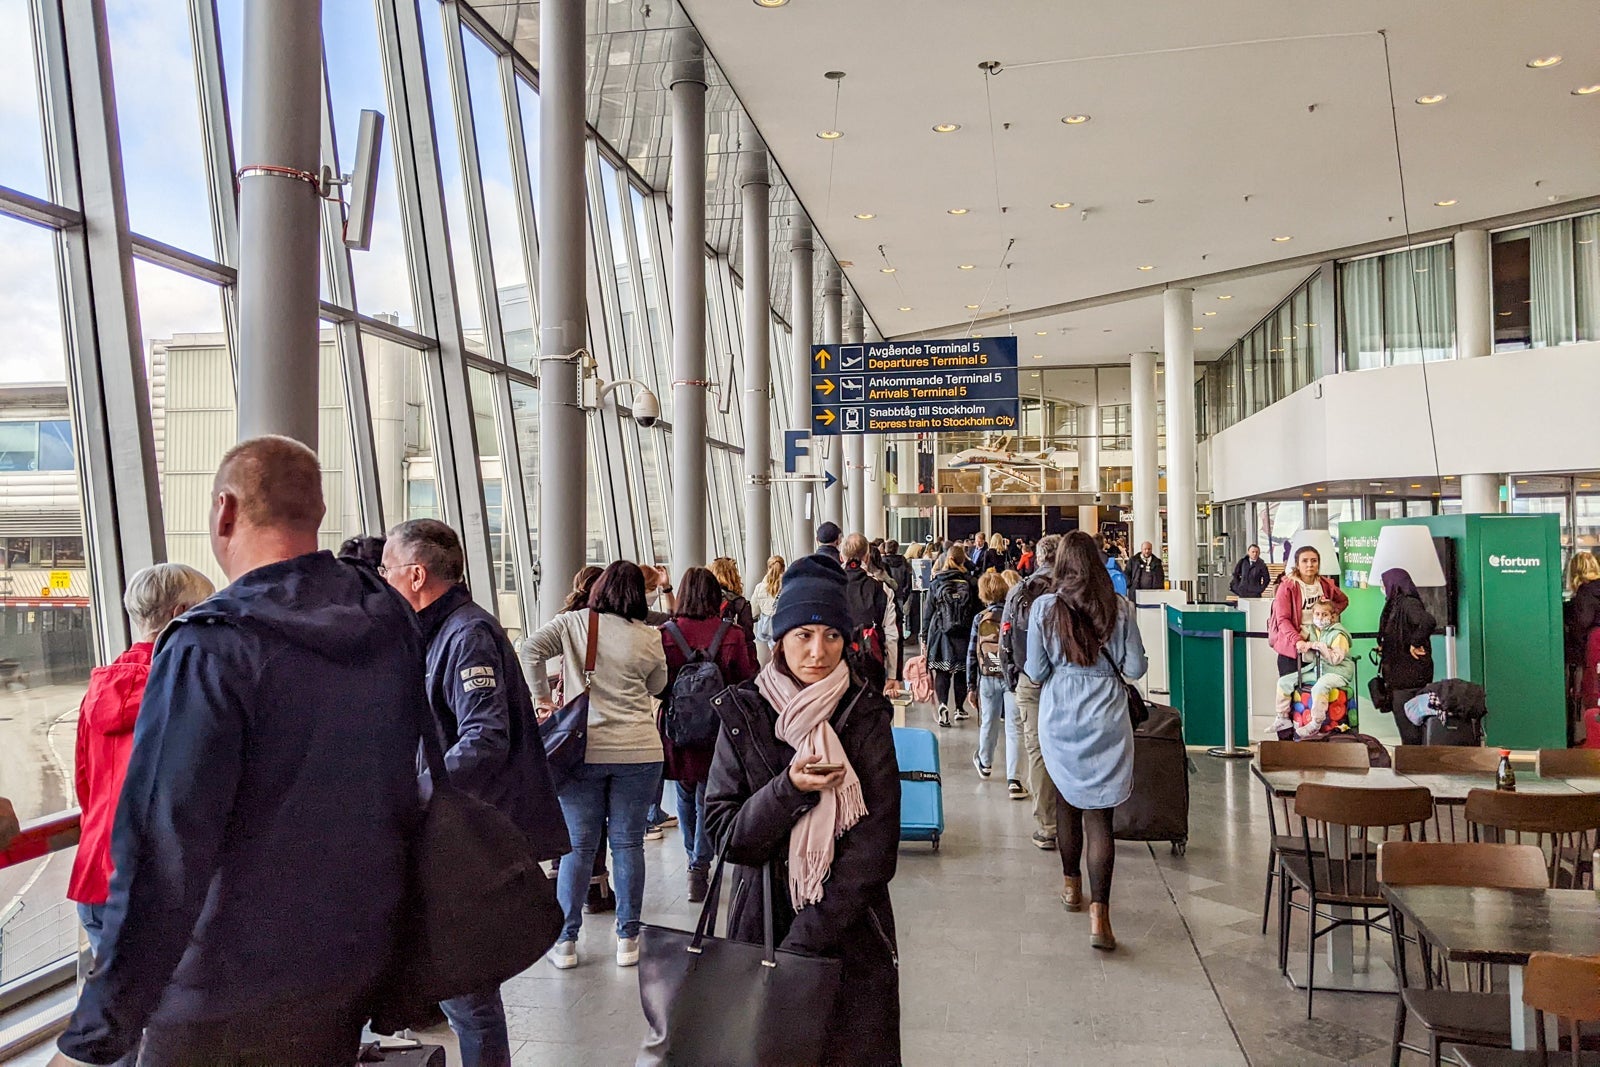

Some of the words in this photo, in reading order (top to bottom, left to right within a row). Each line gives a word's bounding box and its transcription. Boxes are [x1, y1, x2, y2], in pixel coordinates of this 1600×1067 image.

[868, 344, 922, 358] Avgående
[924, 342, 970, 354] Terminal
[972, 342, 980, 352] 5
[868, 357, 929, 370] Departures
[931, 354, 978, 366] Terminal
[980, 354, 988, 364] 5
[869, 374, 943, 387] Ankommande
[945, 373, 992, 384] Terminal
[994, 372, 1002, 382] 5
[869, 388, 909, 399] Arrivals
[911, 386, 958, 398] Terminal
[959, 386, 967, 396] 5
[869, 405, 917, 418] Snabbtåg
[918, 406, 930, 416] till
[931, 404, 986, 416] Stockholm
[869, 419, 907, 430] Express
[908, 418, 930, 428] train
[931, 418, 942, 427] to
[943, 416, 994, 427] Stockholm
[996, 416, 1015, 427] City
[784, 430, 810, 473] F
[1500, 555, 1540, 566] fortum
